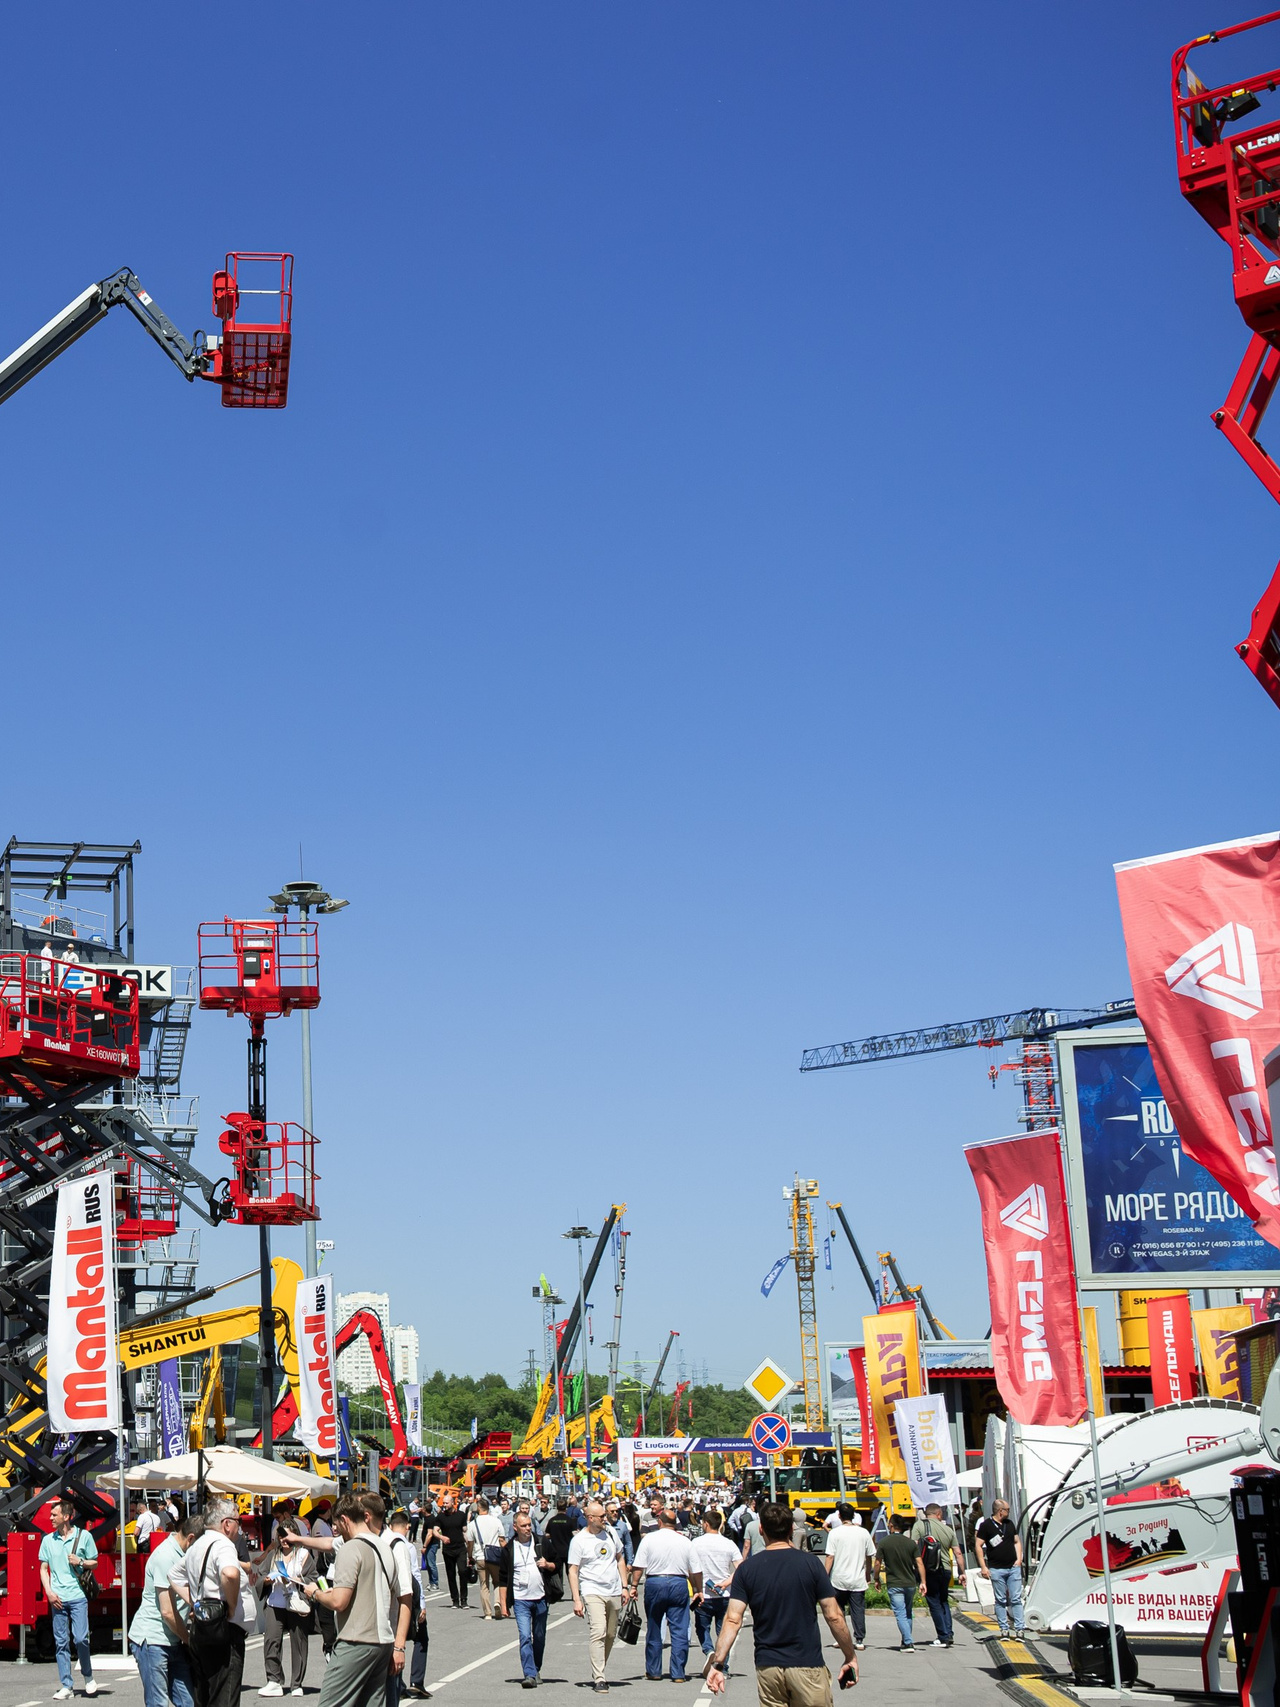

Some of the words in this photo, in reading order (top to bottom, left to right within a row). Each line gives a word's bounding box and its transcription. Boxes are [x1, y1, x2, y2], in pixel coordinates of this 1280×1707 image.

[44, 1038, 71, 1052] Mantall
[25, 1184, 54, 1208] MANTALL.RU
[84, 1183, 101, 1224] RUS
[1105, 1193, 1168, 1223] МОРЕ
[1211, 1240, 1231, 1248] (495)
[315, 1284, 326, 1312] RUS
[63, 1225, 107, 1420] Mantall
[128, 1327, 207, 1358] SHANTUI
[385, 1399, 400, 1425] SANY
[1126, 1526, 1137, 1536] За
[1138, 1517, 1169, 1533] Родину
[1138, 1593, 1176, 1607] ВИДЫ
[1137, 1609, 1164, 1622] ДЛЯ
